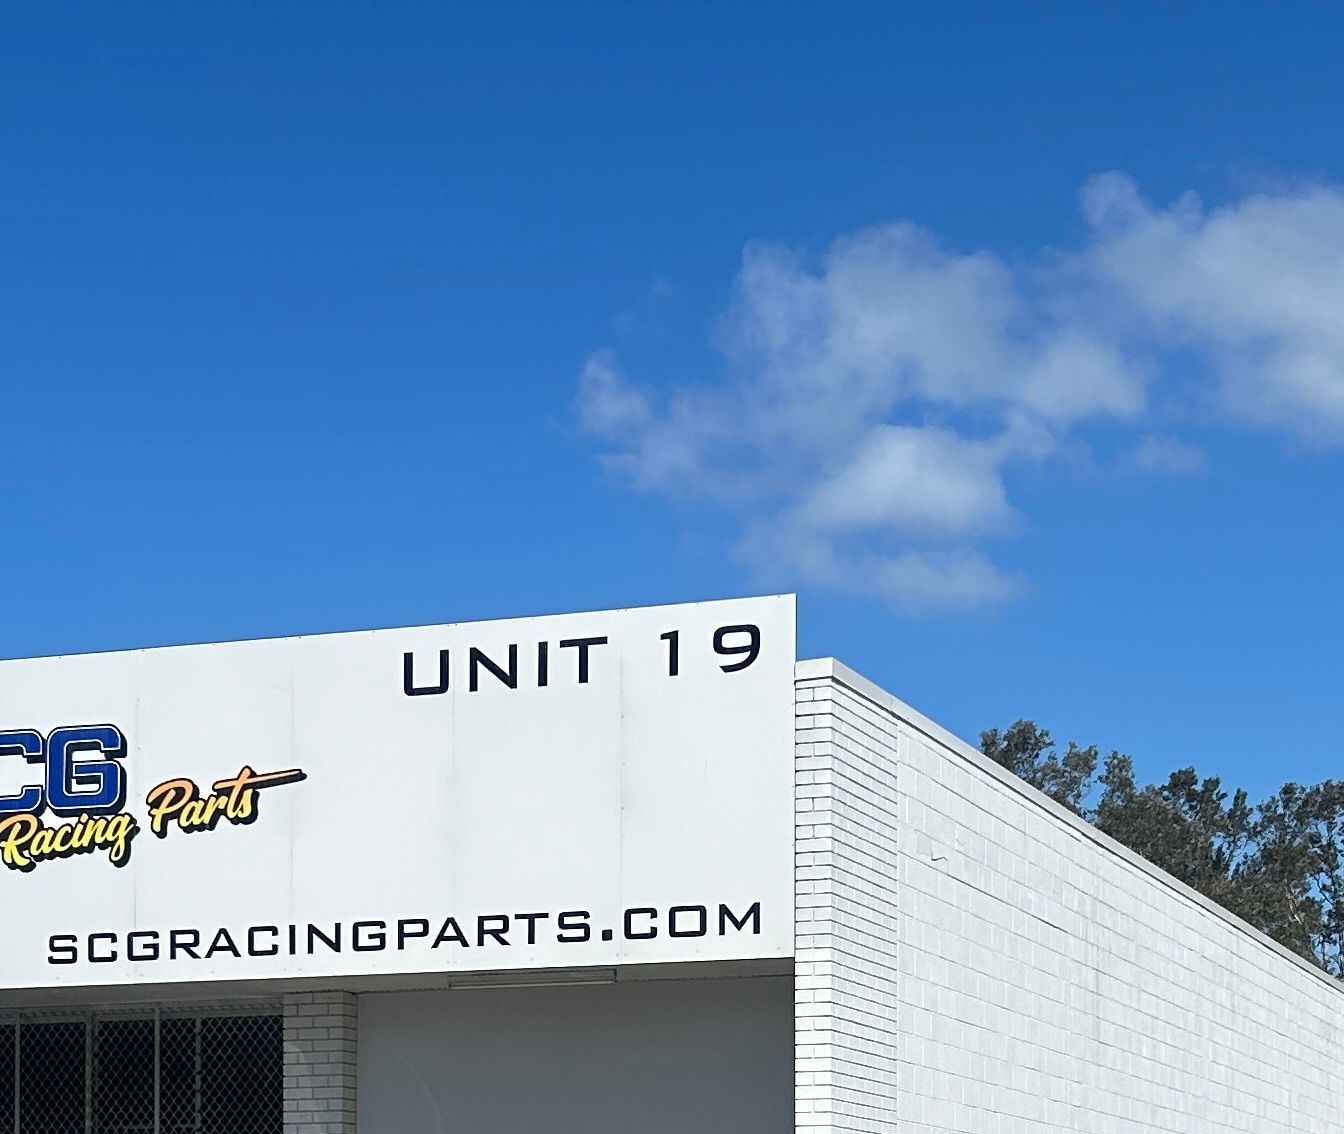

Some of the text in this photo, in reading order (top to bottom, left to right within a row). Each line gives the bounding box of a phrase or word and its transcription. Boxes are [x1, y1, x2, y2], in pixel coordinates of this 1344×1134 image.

[403, 624, 761, 697] UNIT 19
[146, 765, 307, 838] Parts
[47, 902, 761, 965] SCGRACINGPARTS.COM
